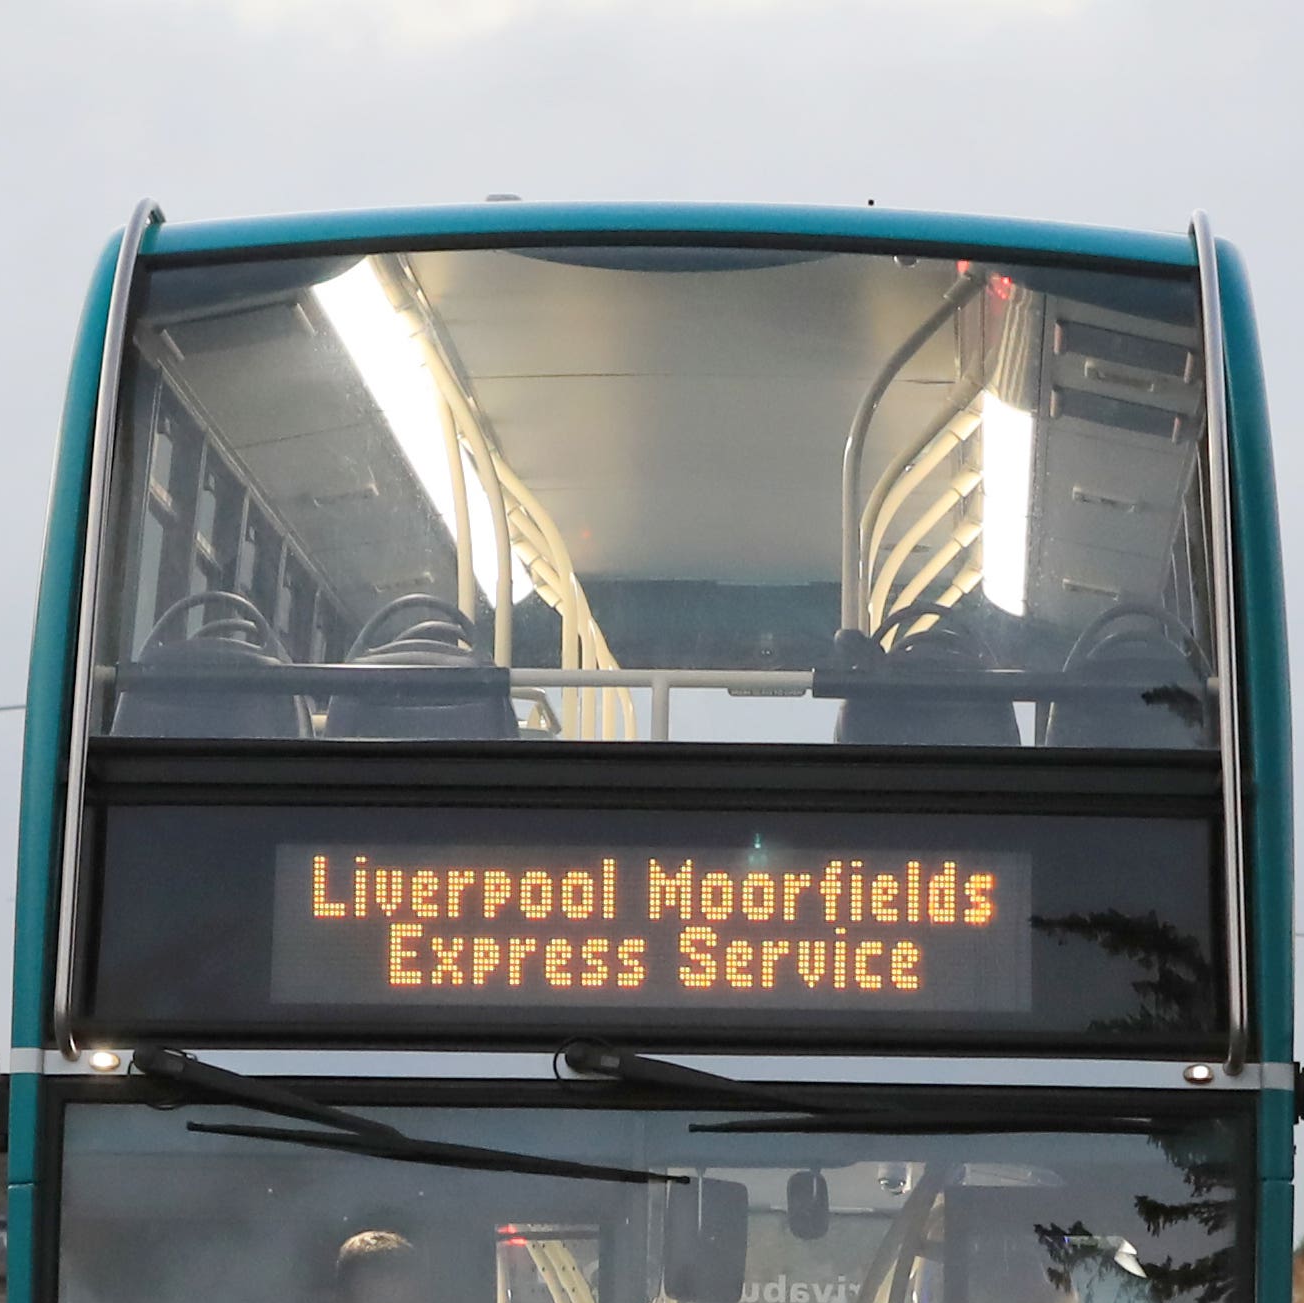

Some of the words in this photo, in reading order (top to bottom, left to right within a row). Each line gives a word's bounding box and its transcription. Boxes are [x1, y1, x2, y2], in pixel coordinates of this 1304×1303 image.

[312, 855, 616, 919] Liverpool
[647, 857, 994, 925] Moorfields
[388, 922, 646, 987] Express
[677, 926, 922, 990] Service
